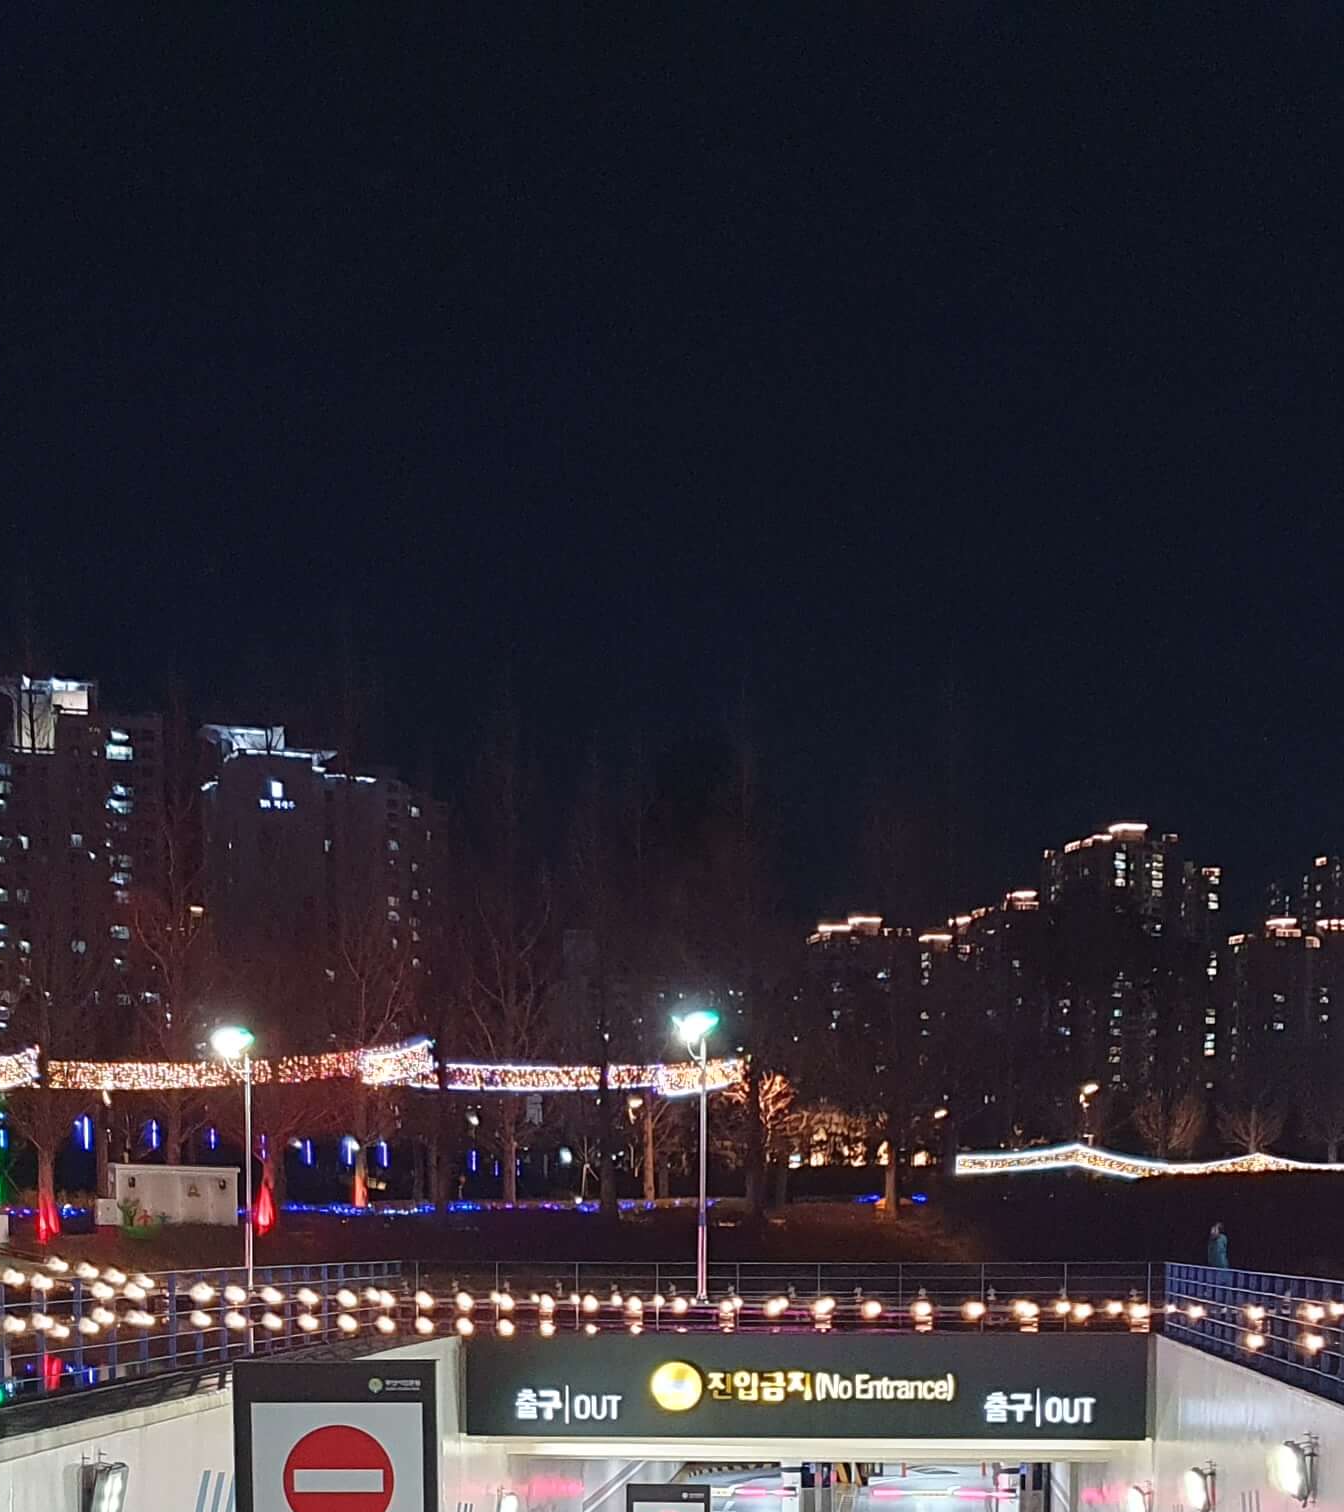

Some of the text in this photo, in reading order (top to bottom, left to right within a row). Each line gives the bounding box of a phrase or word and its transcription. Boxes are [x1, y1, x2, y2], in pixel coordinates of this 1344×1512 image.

[706, 1371, 954, 1401] 진입금지 (No Entrance)
[515, 1388, 622, 1420] 출구 OUT
[983, 1391, 1096, 1423] 출구 OUT
